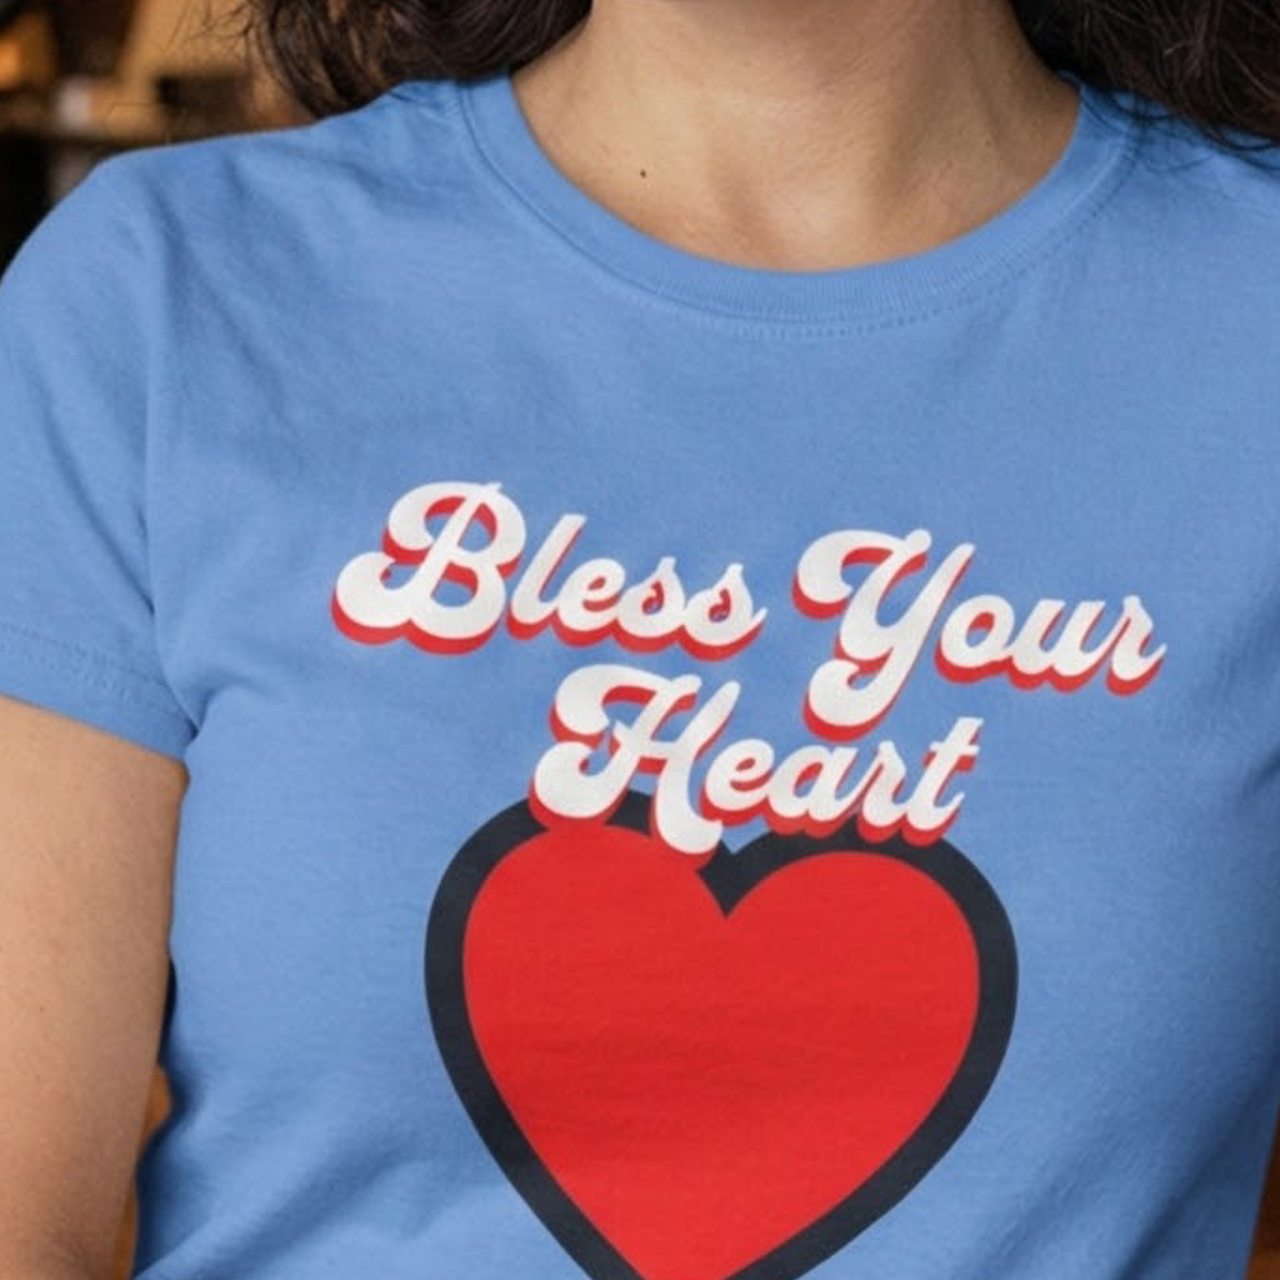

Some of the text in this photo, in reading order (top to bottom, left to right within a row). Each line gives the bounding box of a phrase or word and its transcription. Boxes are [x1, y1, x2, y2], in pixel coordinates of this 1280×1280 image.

[331, 482, 1167, 742] Bless Your
[528, 663, 984, 856] Heart
